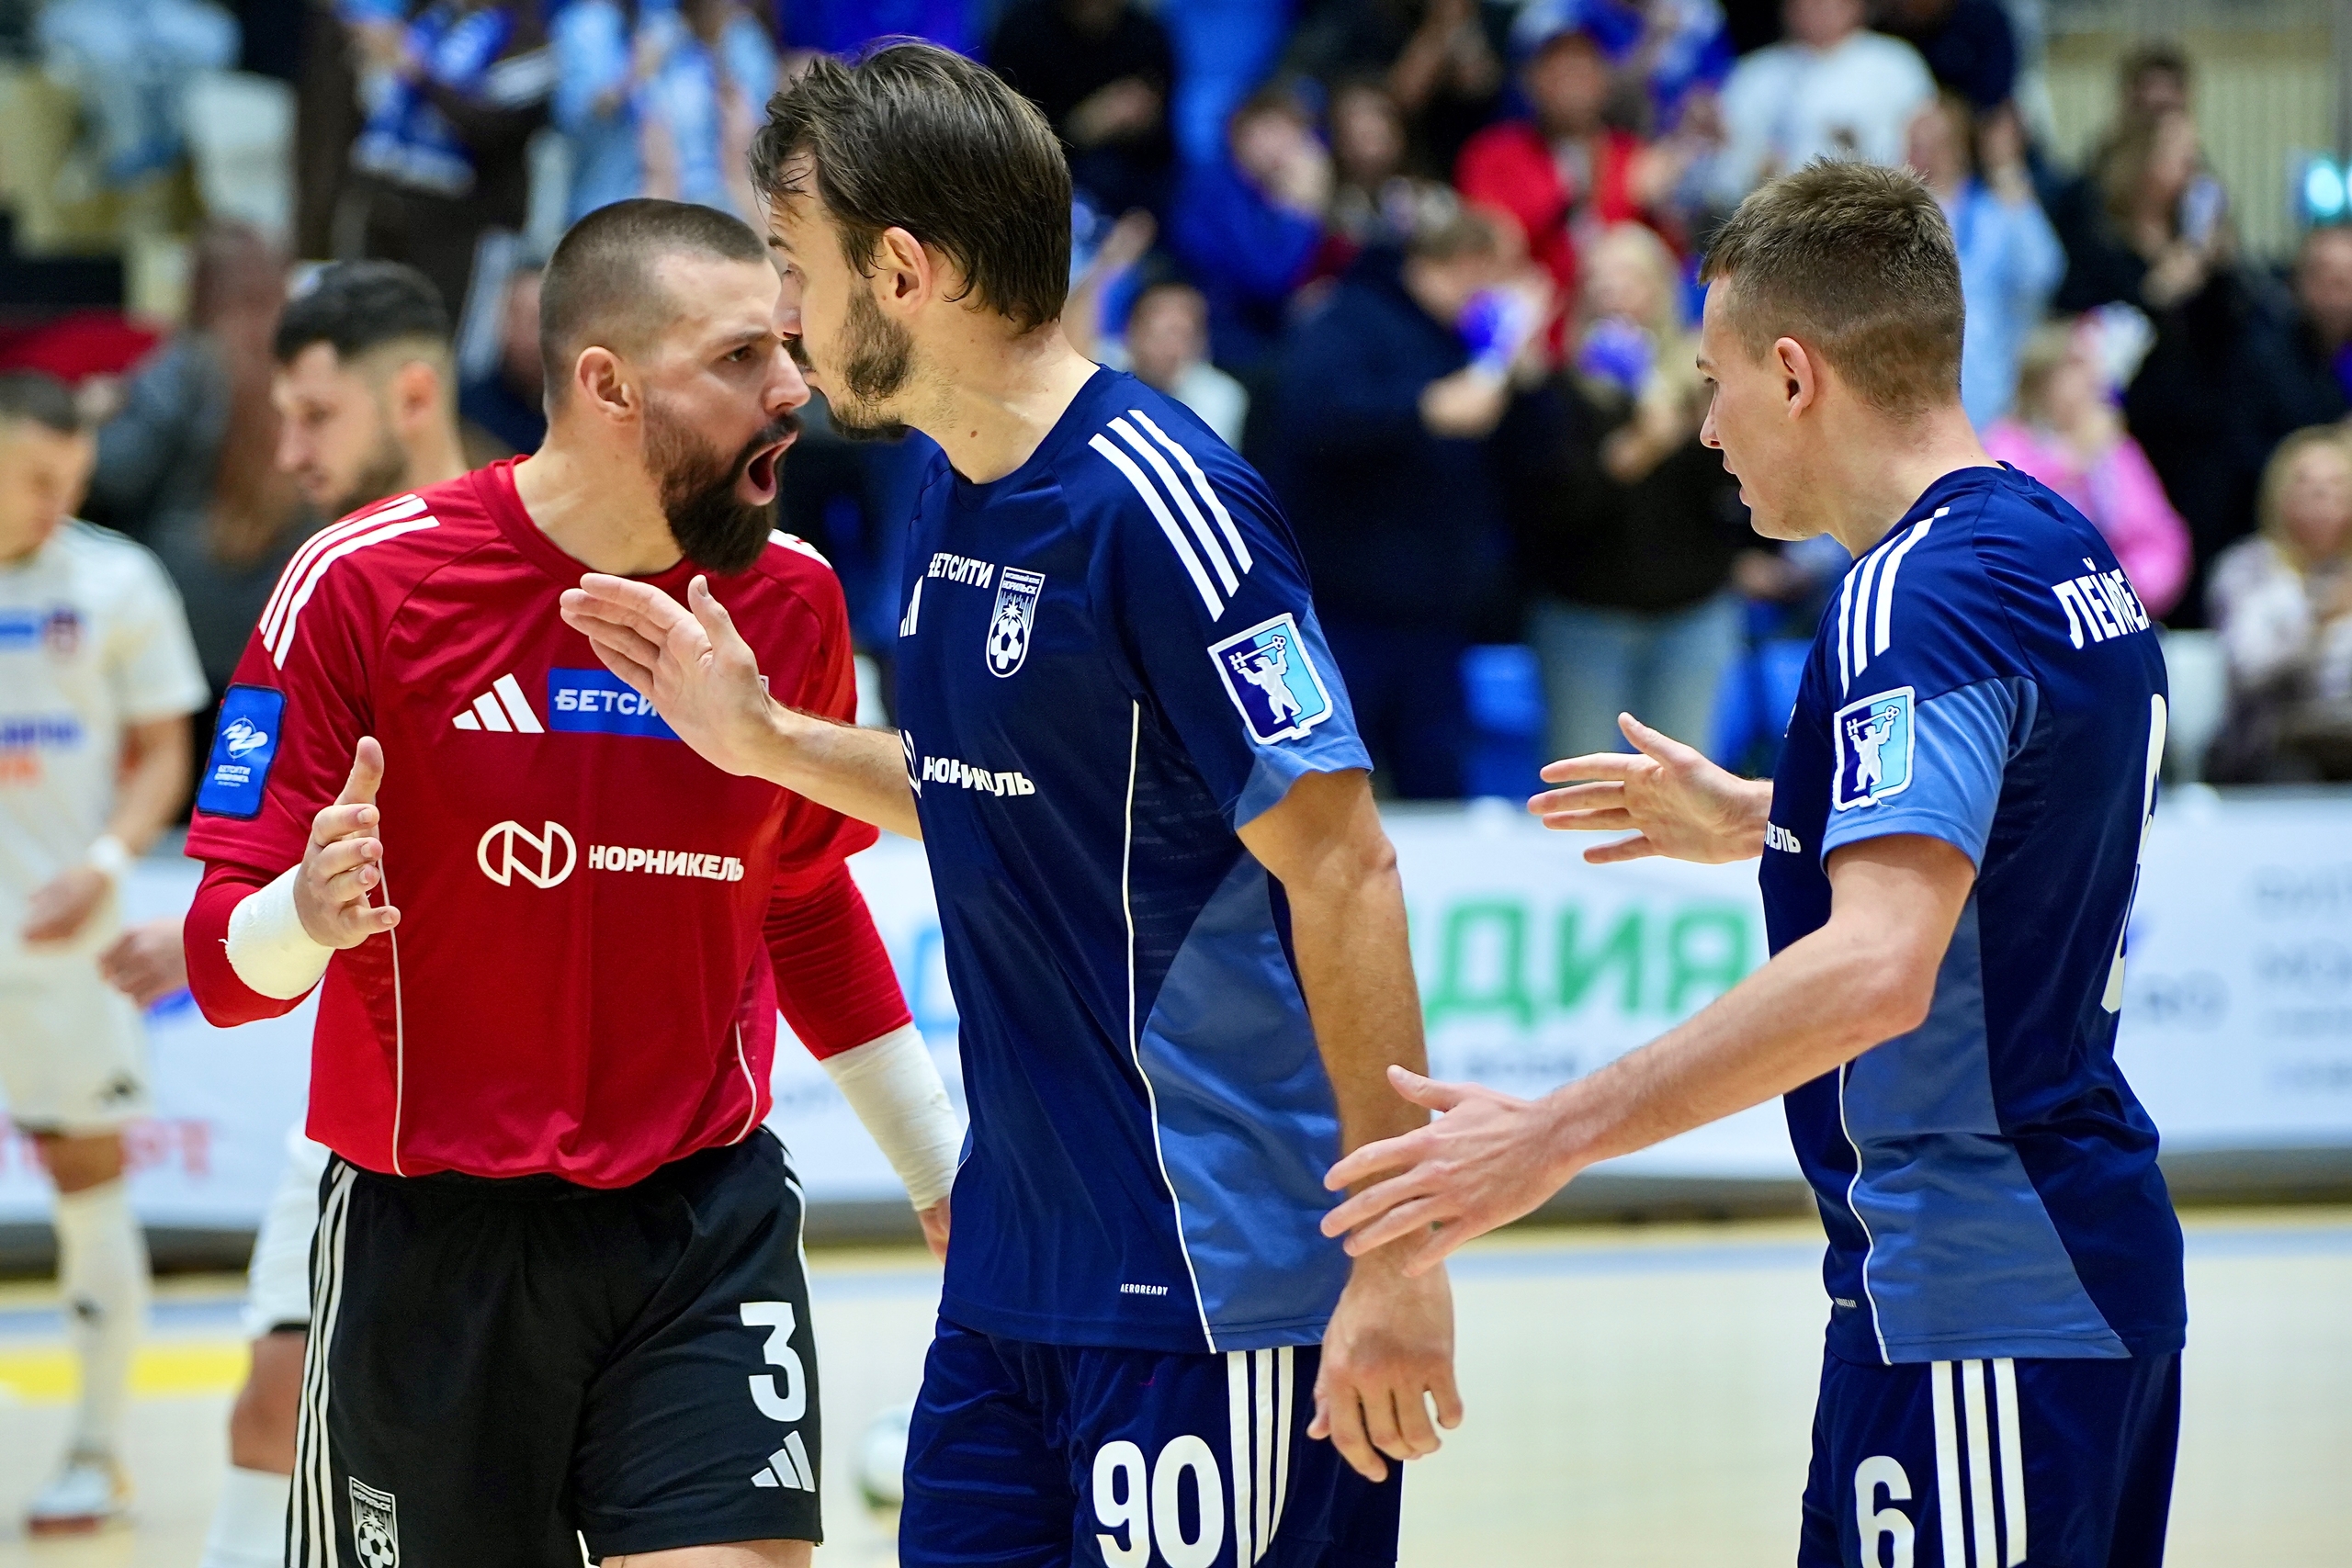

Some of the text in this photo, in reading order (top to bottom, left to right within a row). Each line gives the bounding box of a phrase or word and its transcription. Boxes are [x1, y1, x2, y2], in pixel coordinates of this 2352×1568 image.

[589, 845, 744, 882] НОРНИКЕЛЬ
[1120, 1283, 1168, 1296] AEROREADY
[740, 1302, 807, 1423] 3
[1092, 1435, 1225, 1568] 90
[1854, 1455, 1916, 1568] 6
